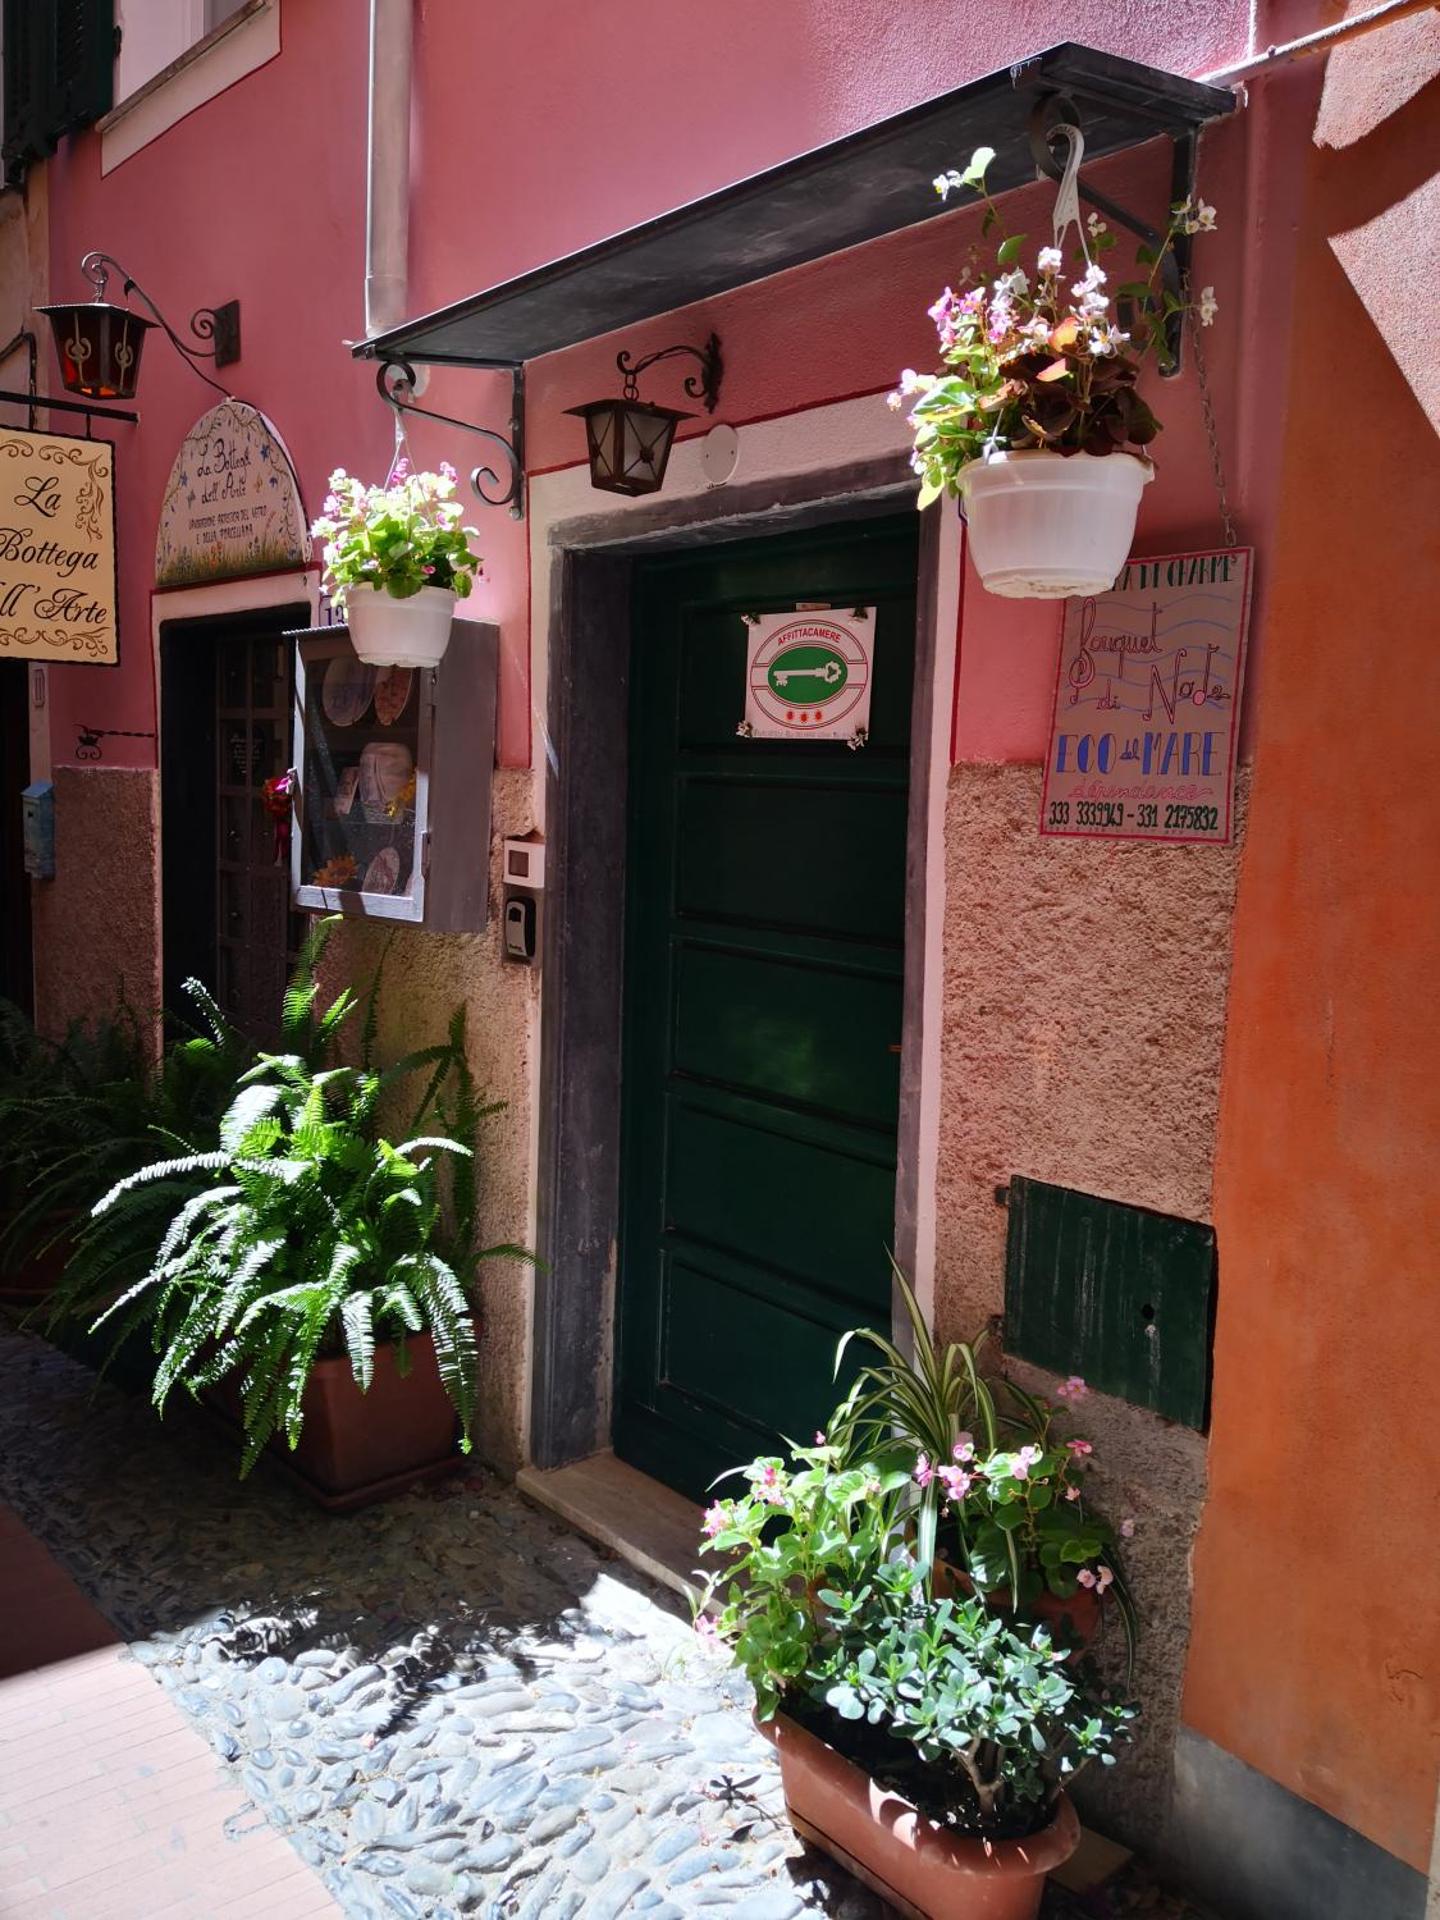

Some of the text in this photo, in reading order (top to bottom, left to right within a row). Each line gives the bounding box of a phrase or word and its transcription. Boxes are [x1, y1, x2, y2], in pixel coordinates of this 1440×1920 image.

[14, 476, 62, 517] La
[0, 528, 98, 577] Bottega
[778, 628, 841, 646] AFFITTACAMERE
[1056, 731, 1225, 776] ECO del MARE
[1049, 801, 1070, 826] 333
[1137, 803, 1158, 828] 331
[1164, 804, 1218, 831] 2175832
